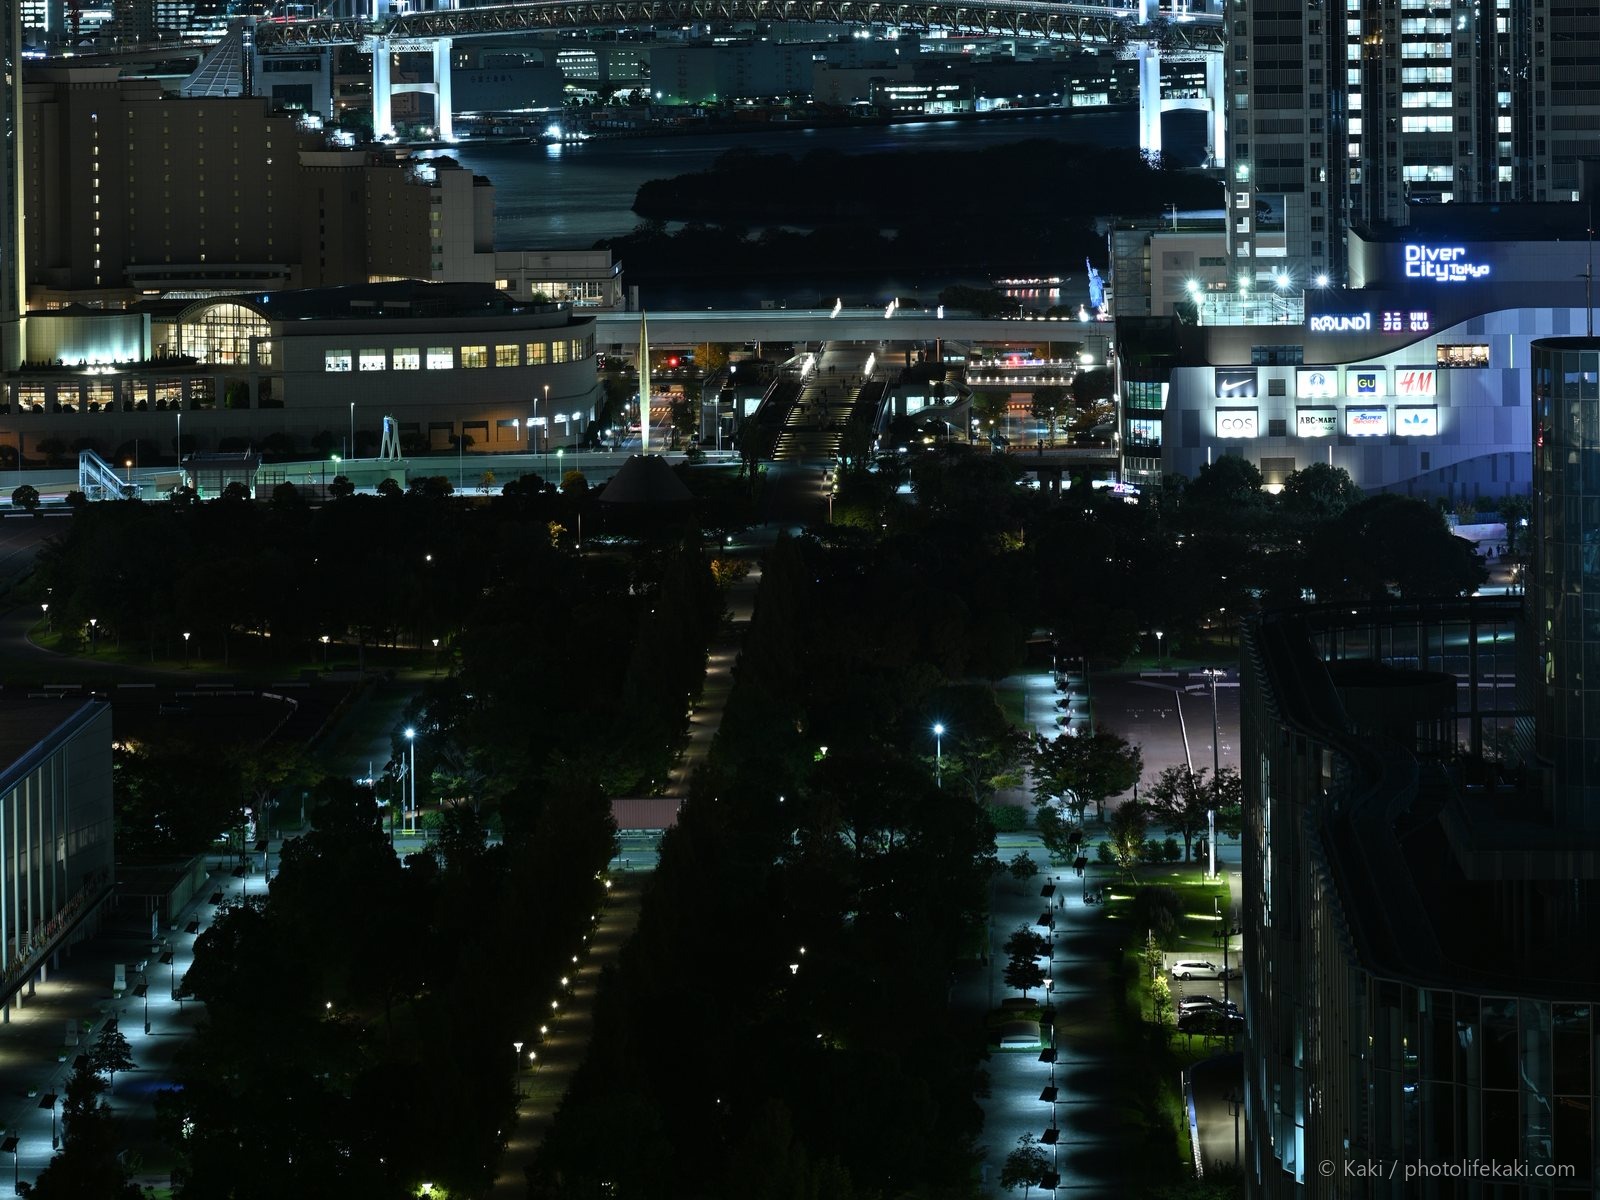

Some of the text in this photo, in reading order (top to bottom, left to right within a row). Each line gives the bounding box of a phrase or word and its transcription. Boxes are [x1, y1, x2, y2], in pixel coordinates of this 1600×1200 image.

[1405, 245, 1465, 261] Diver
[1405, 261, 1449, 281] City
[1358, 378, 1376, 388] GU
[1221, 418, 1253, 430] COS
[1300, 416, 1337, 425] ABC-MART
